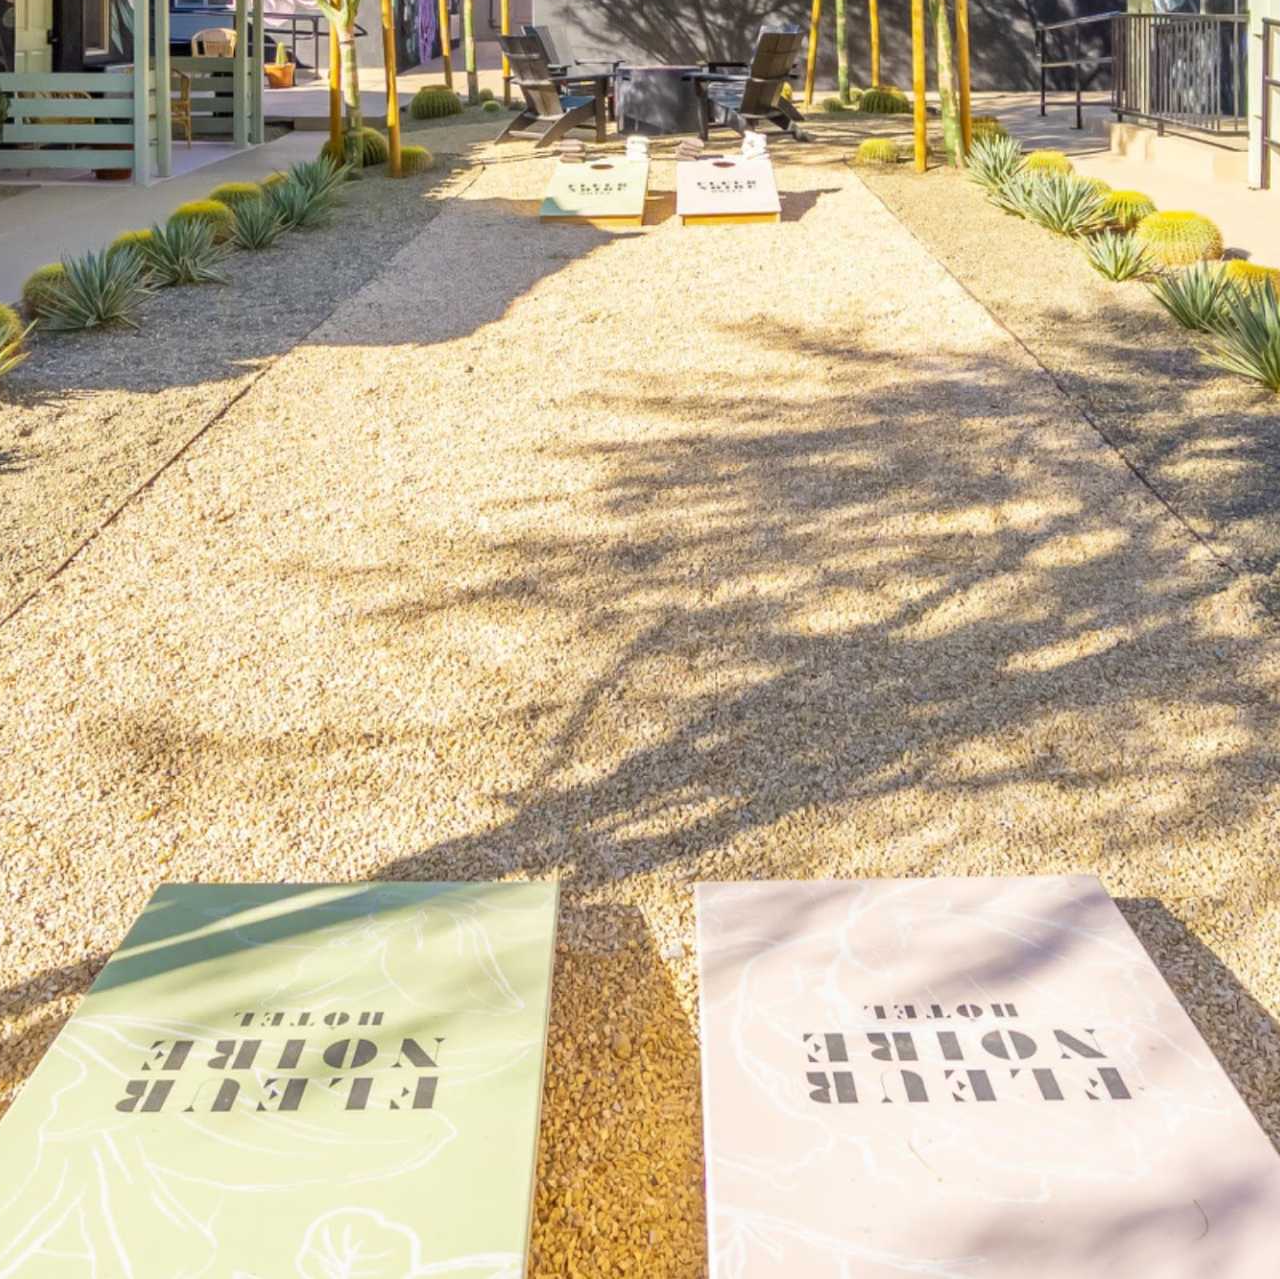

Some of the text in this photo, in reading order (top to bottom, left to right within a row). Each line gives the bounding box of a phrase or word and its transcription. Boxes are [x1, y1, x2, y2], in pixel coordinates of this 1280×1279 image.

[234, 1012, 384, 1027] HOTEL
[864, 1003, 1019, 1020] HOTEL
[141, 1038, 445, 1070] NOIRE
[803, 1029, 1108, 1062] NOIRE
[115, 1077, 439, 1112] FLEUR
[806, 1068, 1133, 1104] FLEUR
